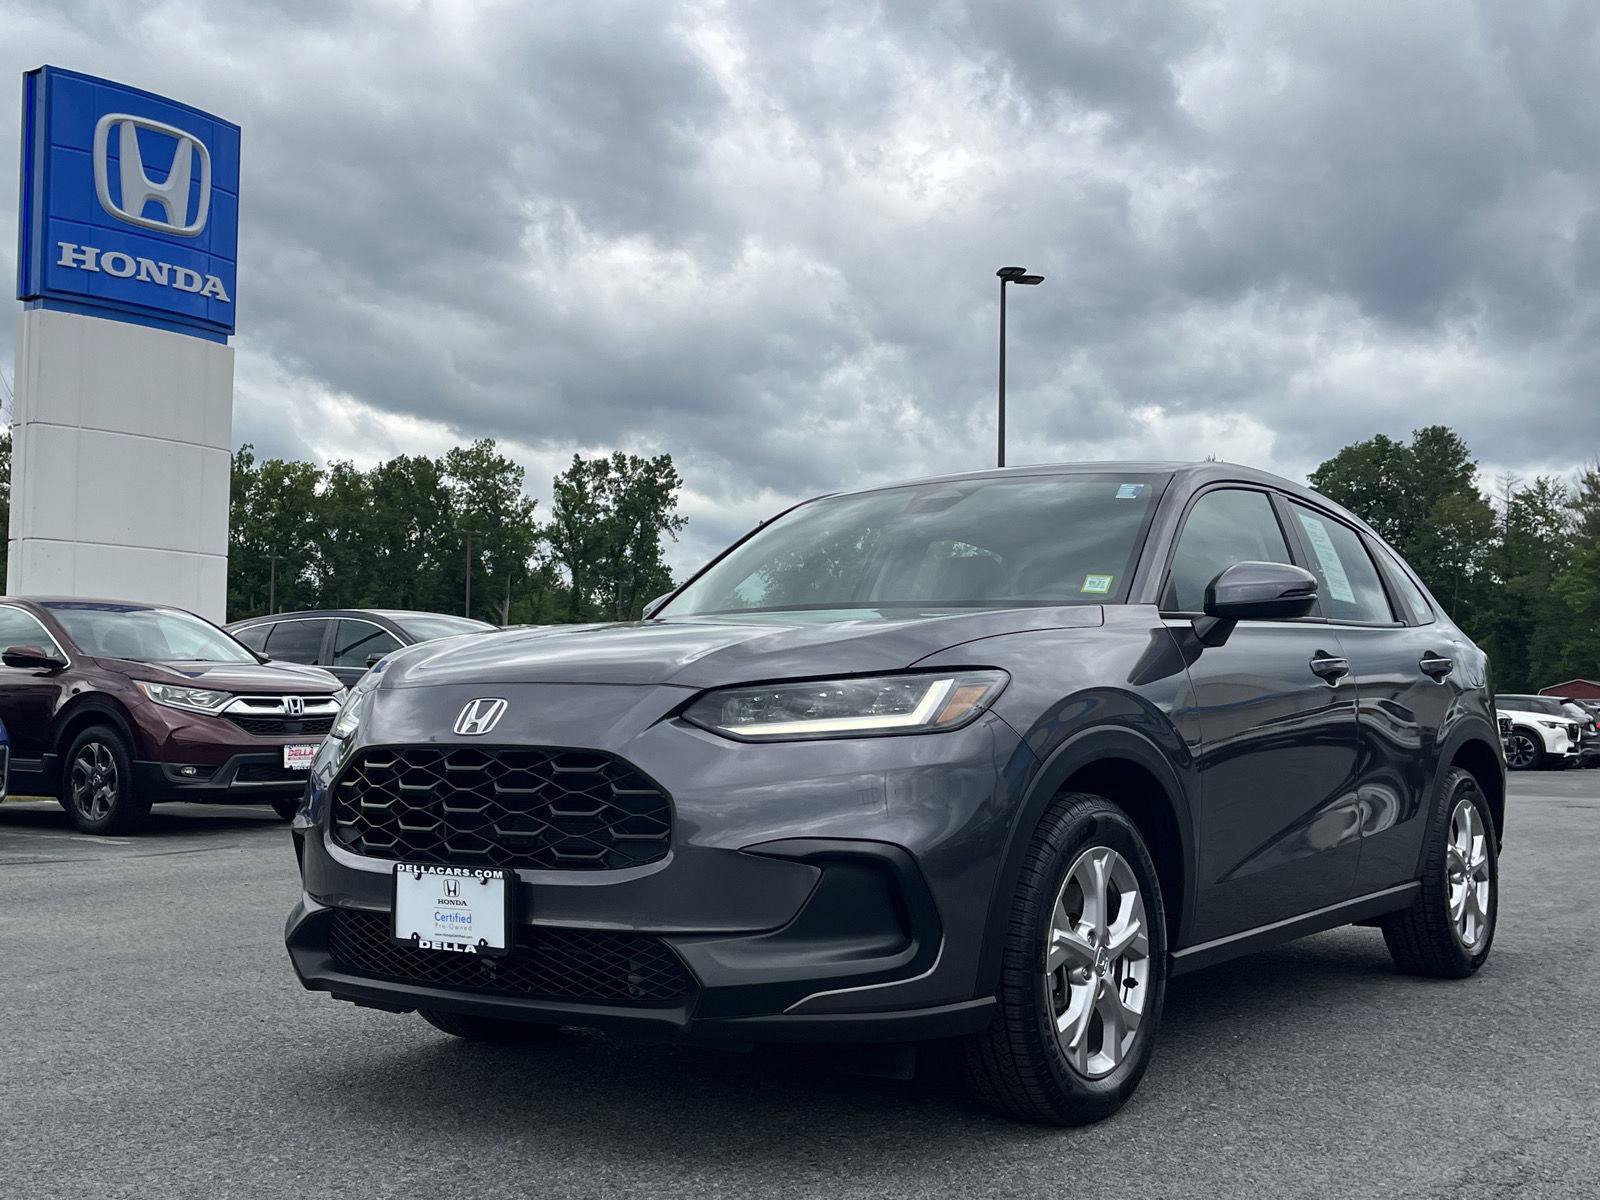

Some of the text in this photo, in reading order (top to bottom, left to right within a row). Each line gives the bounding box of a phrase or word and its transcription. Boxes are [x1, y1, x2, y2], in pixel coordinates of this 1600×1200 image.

[57, 241, 231, 303] HONDA
[288, 749, 314, 757] DELLA
[397, 863, 503, 879] DELLACARS.COM
[437, 898, 468, 907] HONDA
[434, 911, 472, 924] Certified
[418, 940, 477, 954] DELLA
